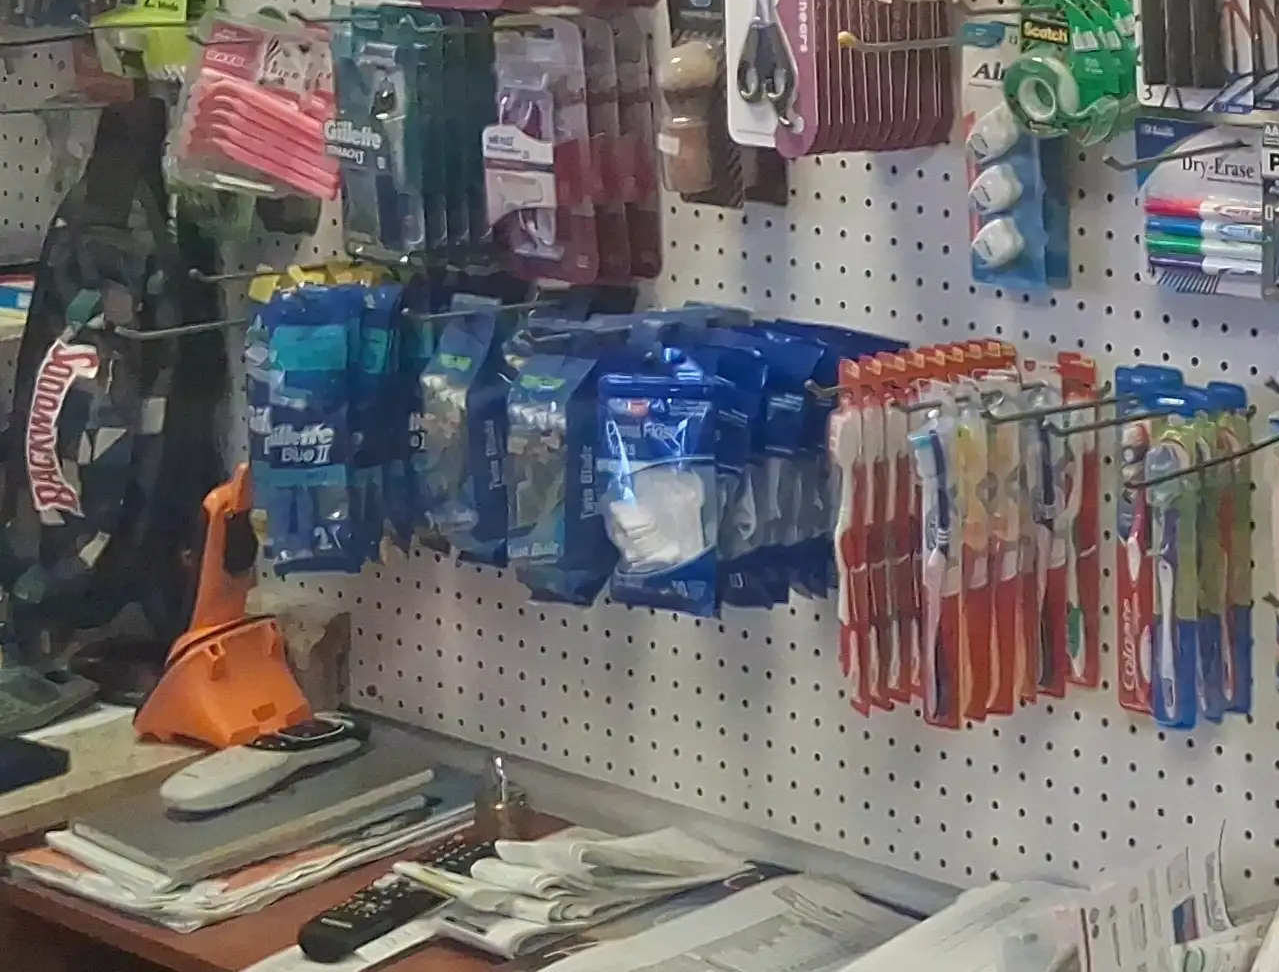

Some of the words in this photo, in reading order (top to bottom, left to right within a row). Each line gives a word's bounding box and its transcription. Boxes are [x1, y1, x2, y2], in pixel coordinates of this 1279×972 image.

[1023, 20, 1069, 45] Scotch
[324, 121, 382, 149] Gillette
[1182, 155, 1255, 180] Dry-Erase
[26, 343, 99, 516] BACKWOODS
[1122, 597, 1139, 692] Colgate
